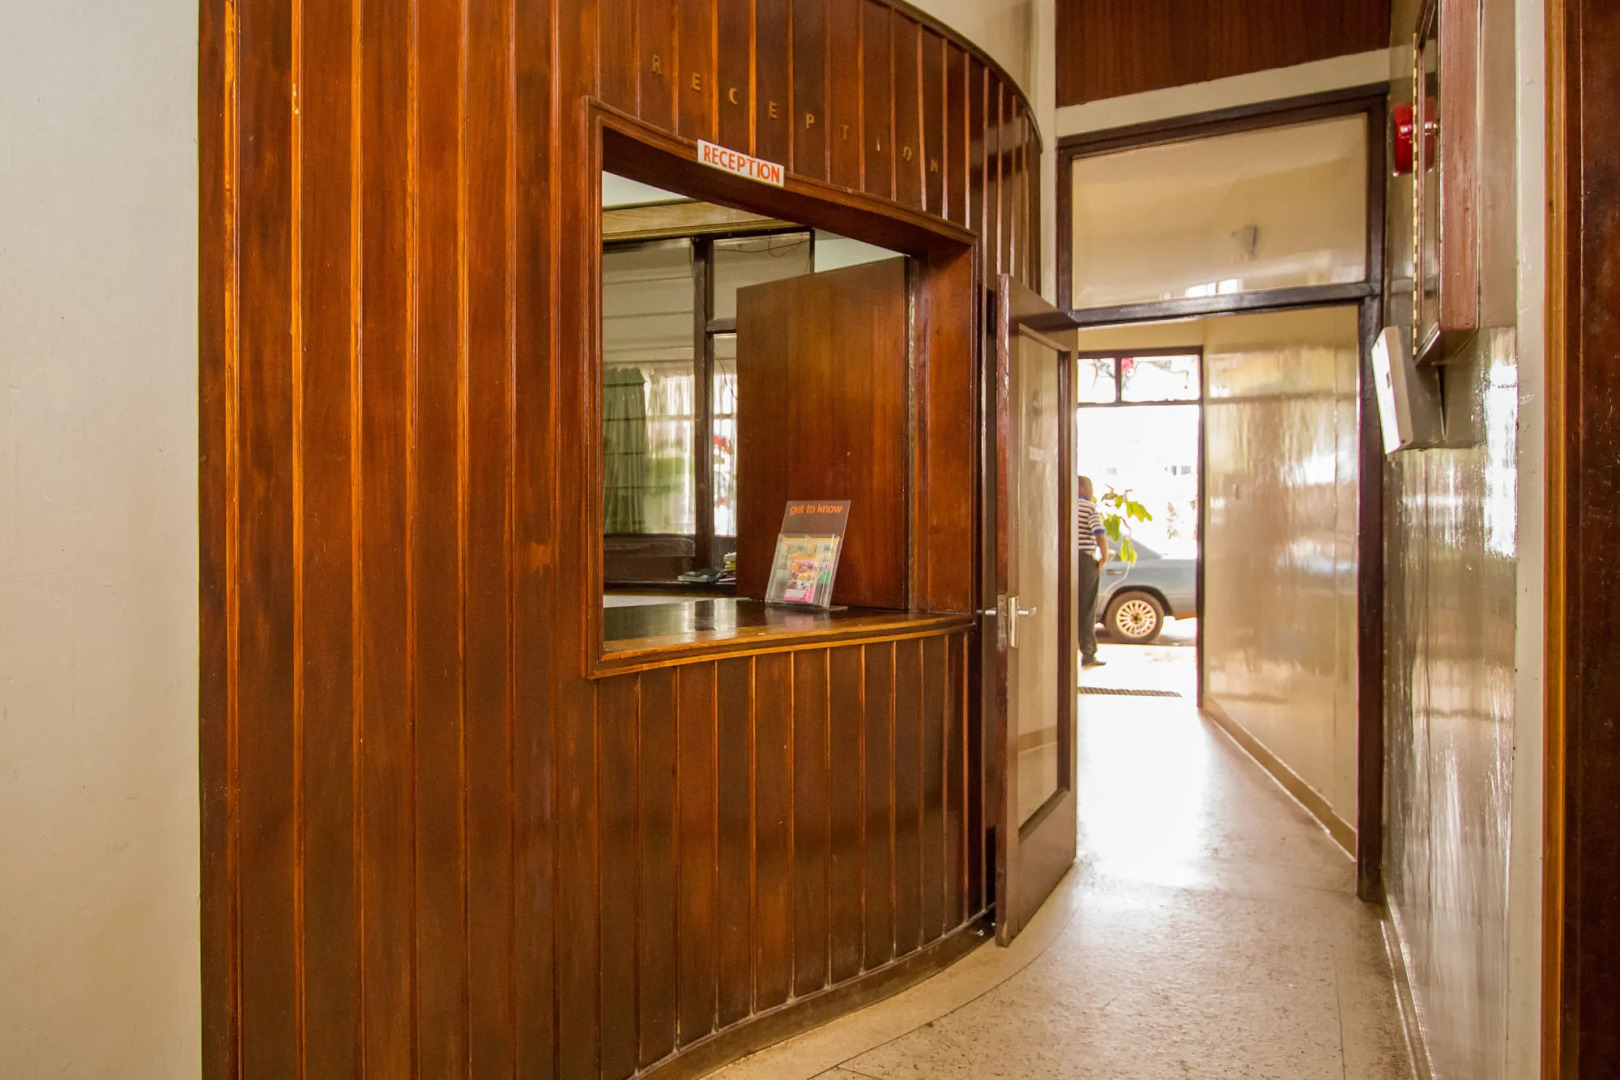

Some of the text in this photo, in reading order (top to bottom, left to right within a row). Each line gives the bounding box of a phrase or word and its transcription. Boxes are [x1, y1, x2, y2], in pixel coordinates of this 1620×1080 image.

[652, 54, 939, 172] RECEPTION
[703, 144, 780, 184] RECEPTION
[790, 503, 843, 517] get to know
